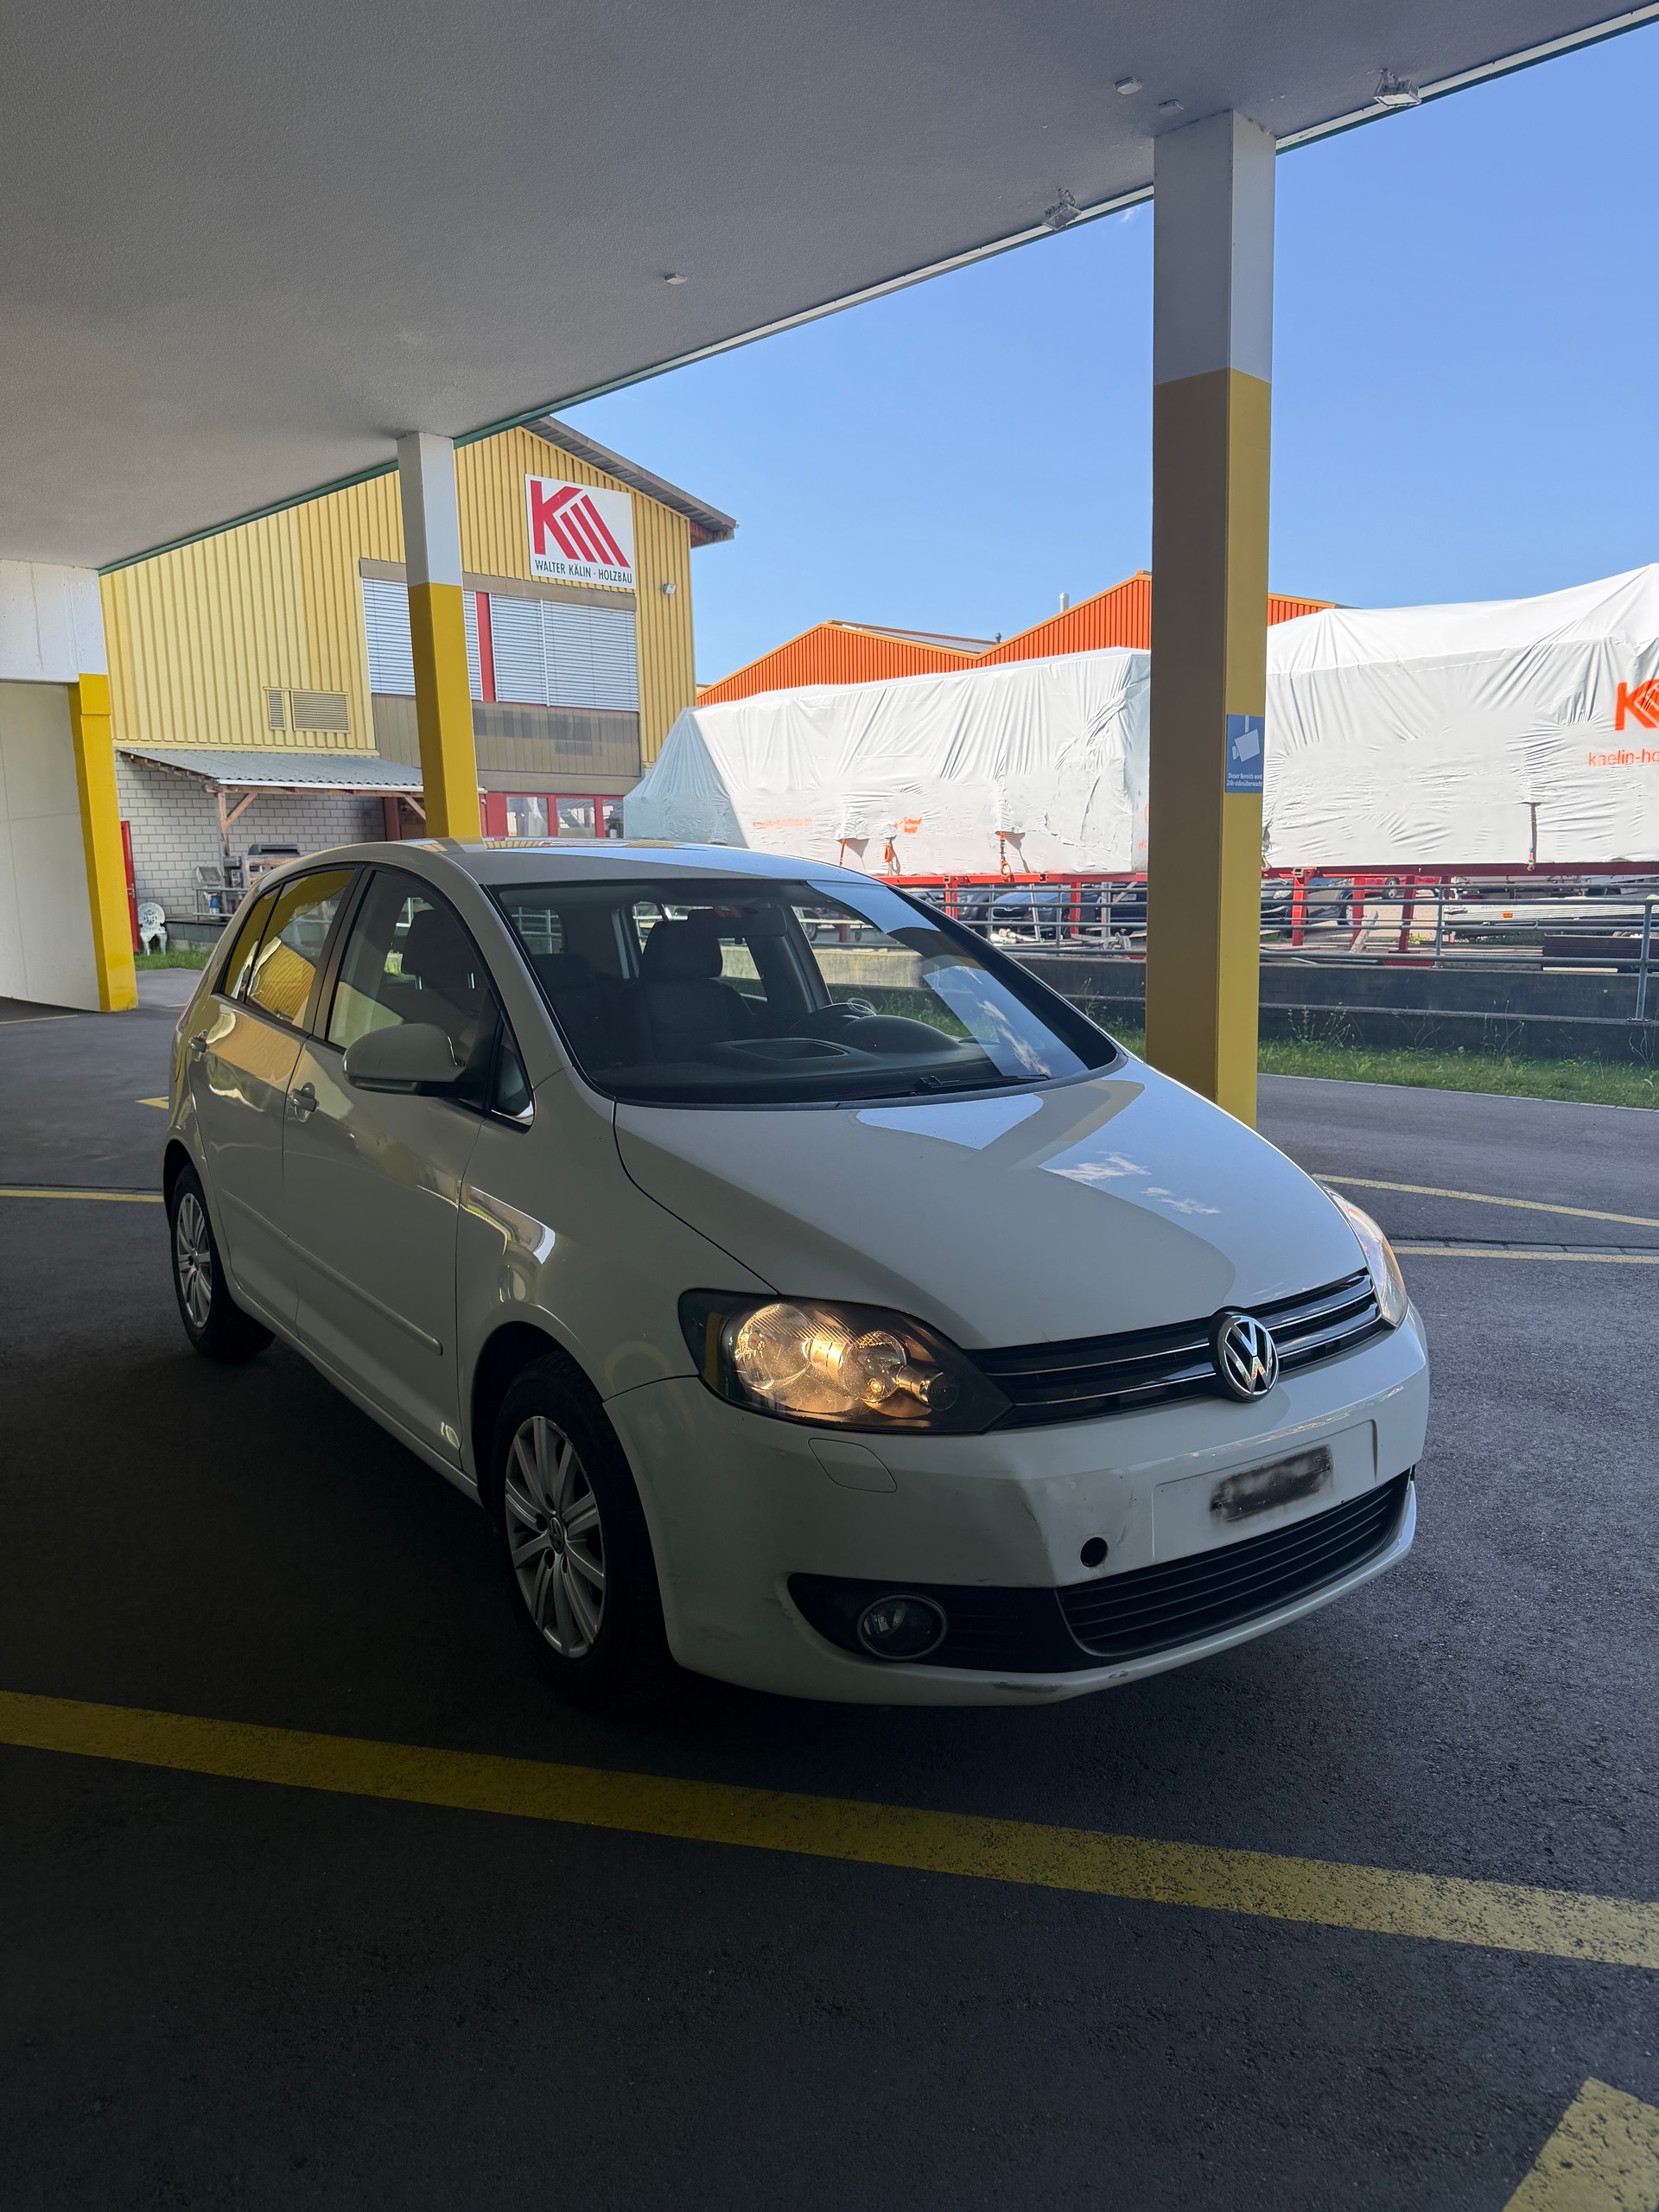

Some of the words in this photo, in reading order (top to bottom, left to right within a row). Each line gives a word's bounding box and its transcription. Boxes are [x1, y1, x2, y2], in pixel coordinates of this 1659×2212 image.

[534, 560, 566, 575] WALTER
[569, 563, 591, 578] KÄLIN
[598, 569, 632, 584] HOLZBAU
[1218, 1315, 1278, 1395] VW
